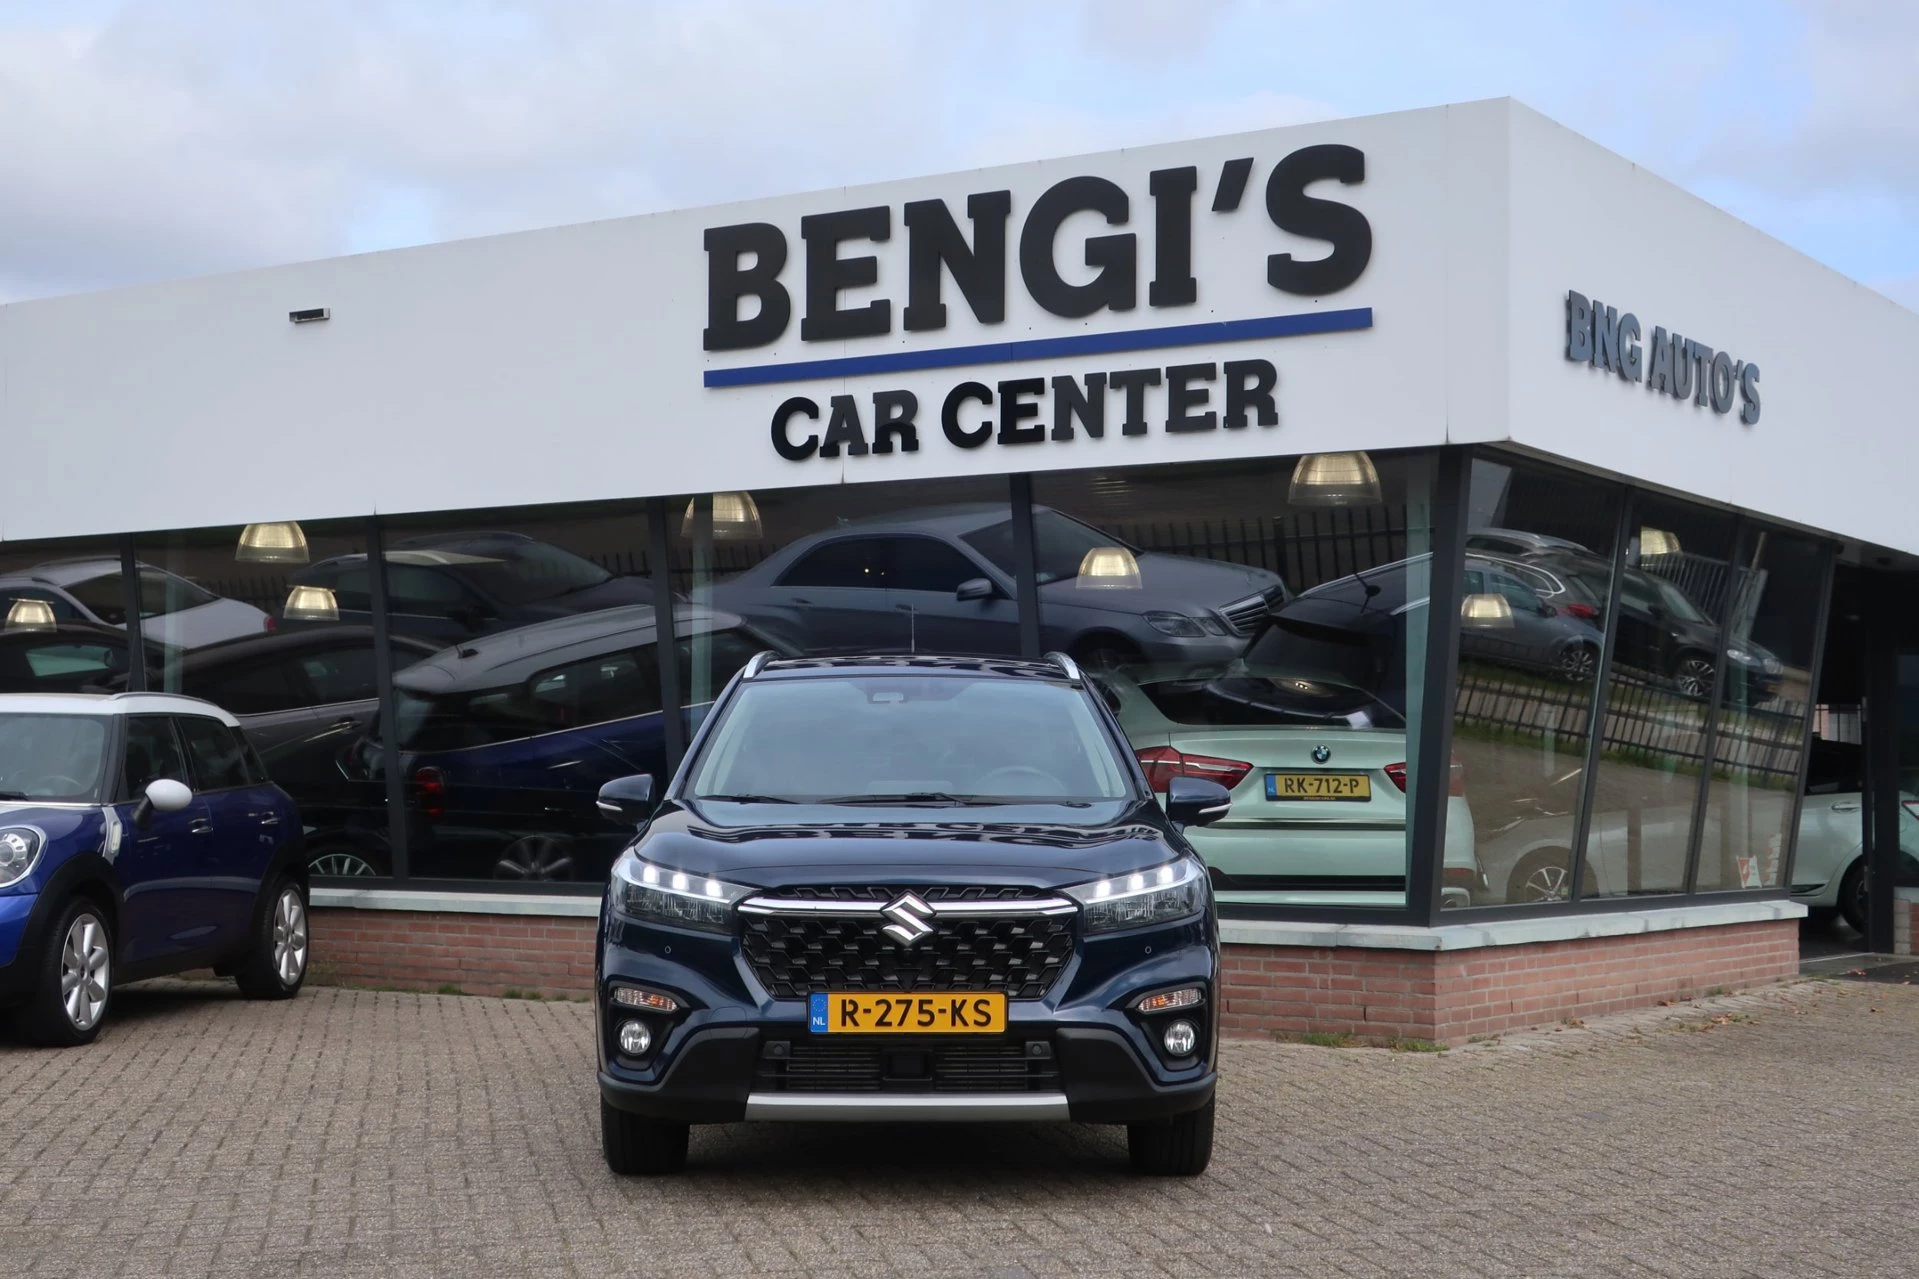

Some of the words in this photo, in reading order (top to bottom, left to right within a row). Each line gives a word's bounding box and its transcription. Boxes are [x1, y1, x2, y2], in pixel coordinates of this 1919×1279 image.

[702, 144, 1373, 351] BENGI'S
[1566, 289, 1642, 383] BNG
[1648, 325, 1761, 425] AUTO'S
[770, 389, 919, 462] CAR
[941, 359, 1279, 450] CENTER
[1284, 778, 1359, 793] RK-712-P
[812, 1016, 826, 1026] NL
[841, 999, 992, 1027] R-275-KS
